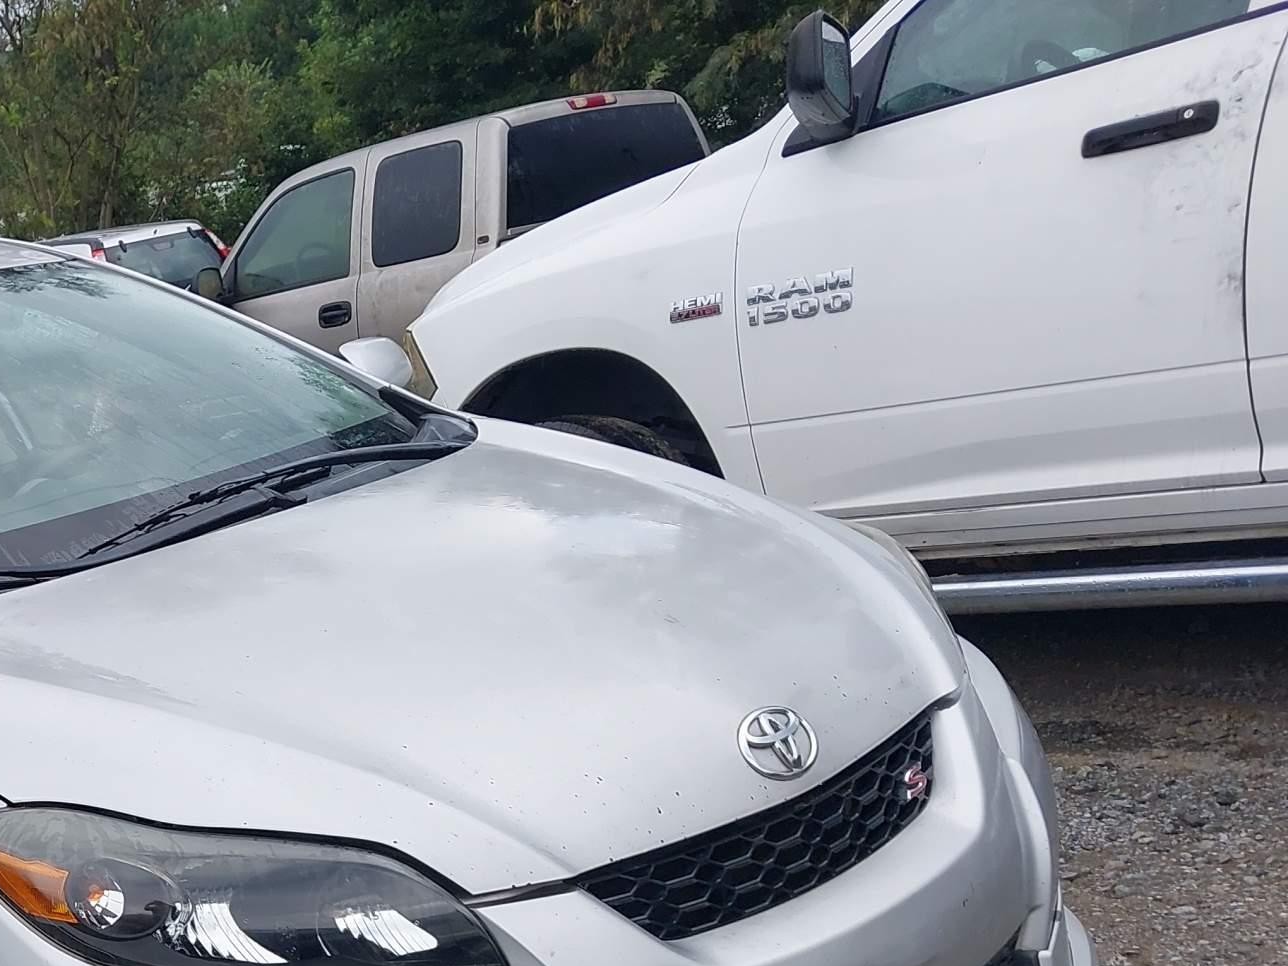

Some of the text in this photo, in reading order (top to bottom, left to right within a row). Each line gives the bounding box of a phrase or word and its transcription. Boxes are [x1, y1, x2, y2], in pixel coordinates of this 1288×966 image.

[670, 291, 723, 313] HEMI
[747, 267, 854, 306] RAM
[747, 291, 853, 328] 1500
